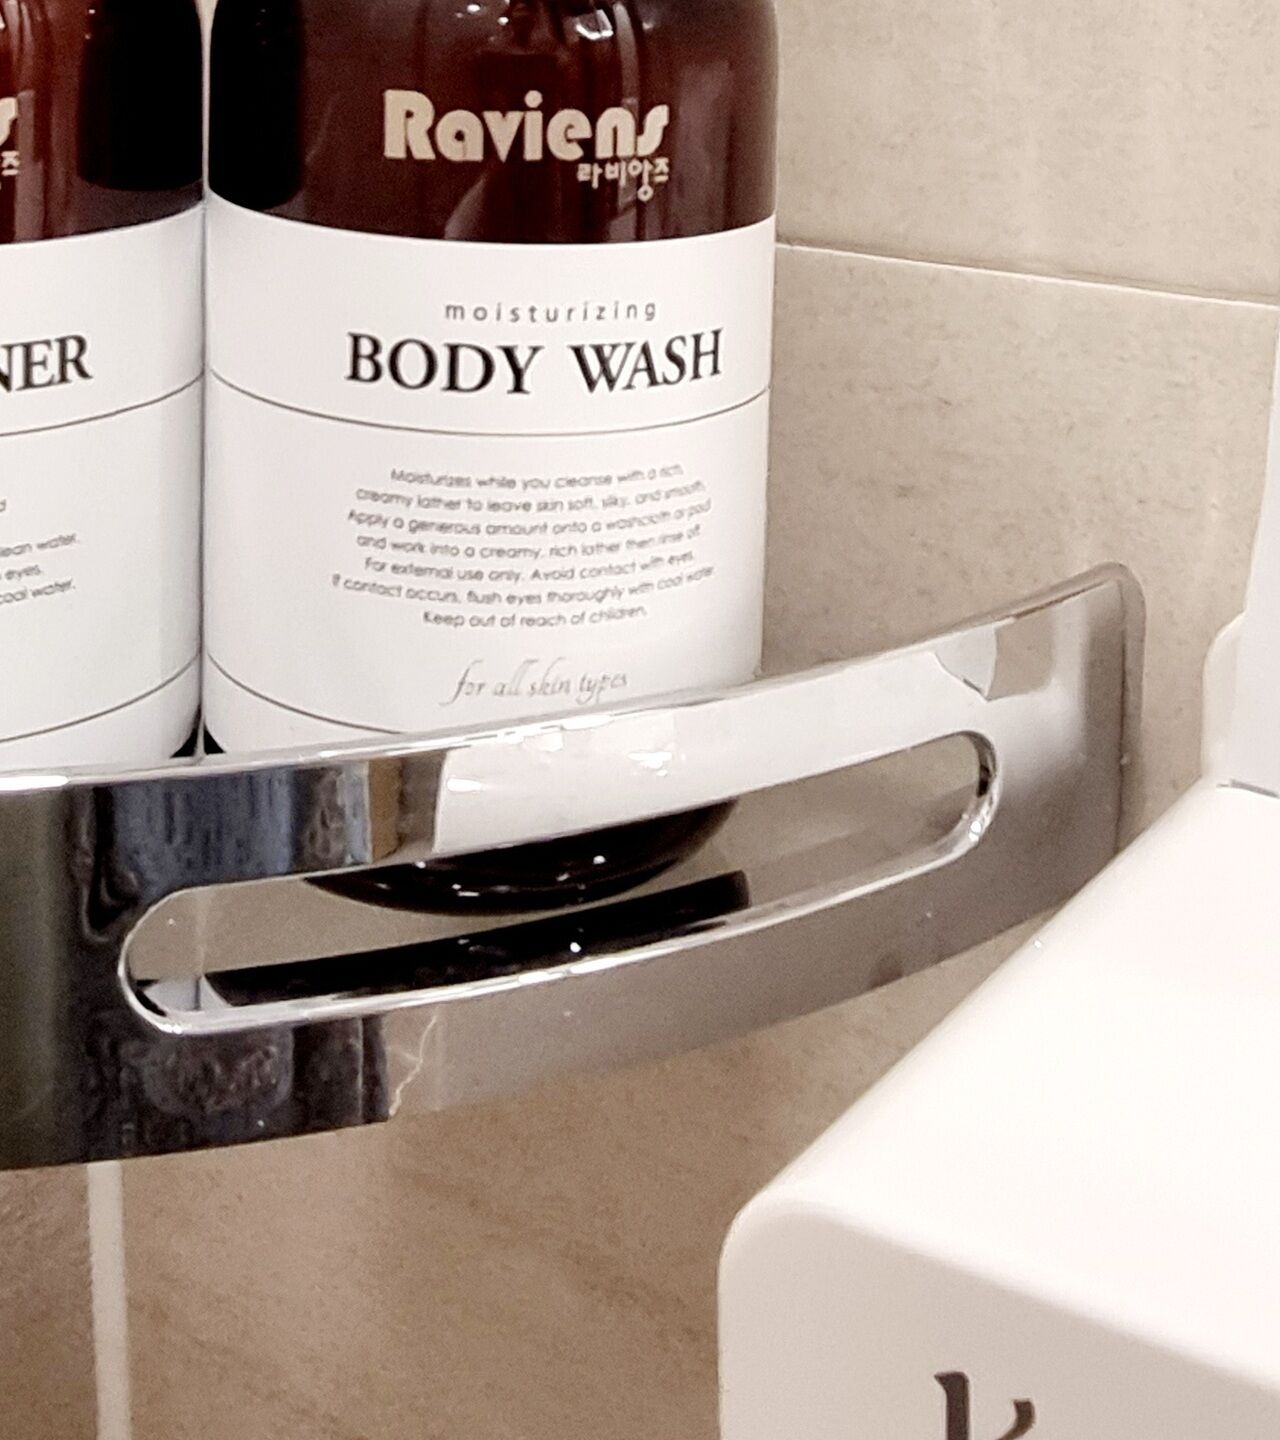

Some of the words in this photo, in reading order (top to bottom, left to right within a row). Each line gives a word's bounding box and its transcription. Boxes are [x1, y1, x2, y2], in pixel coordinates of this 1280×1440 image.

[383, 89, 670, 163] Raviens
[576, 157, 670, 202] 라비앙즈
[445, 300, 657, 323] moisturizing
[345, 331, 545, 395] BODY
[571, 328, 723, 394] WASH
